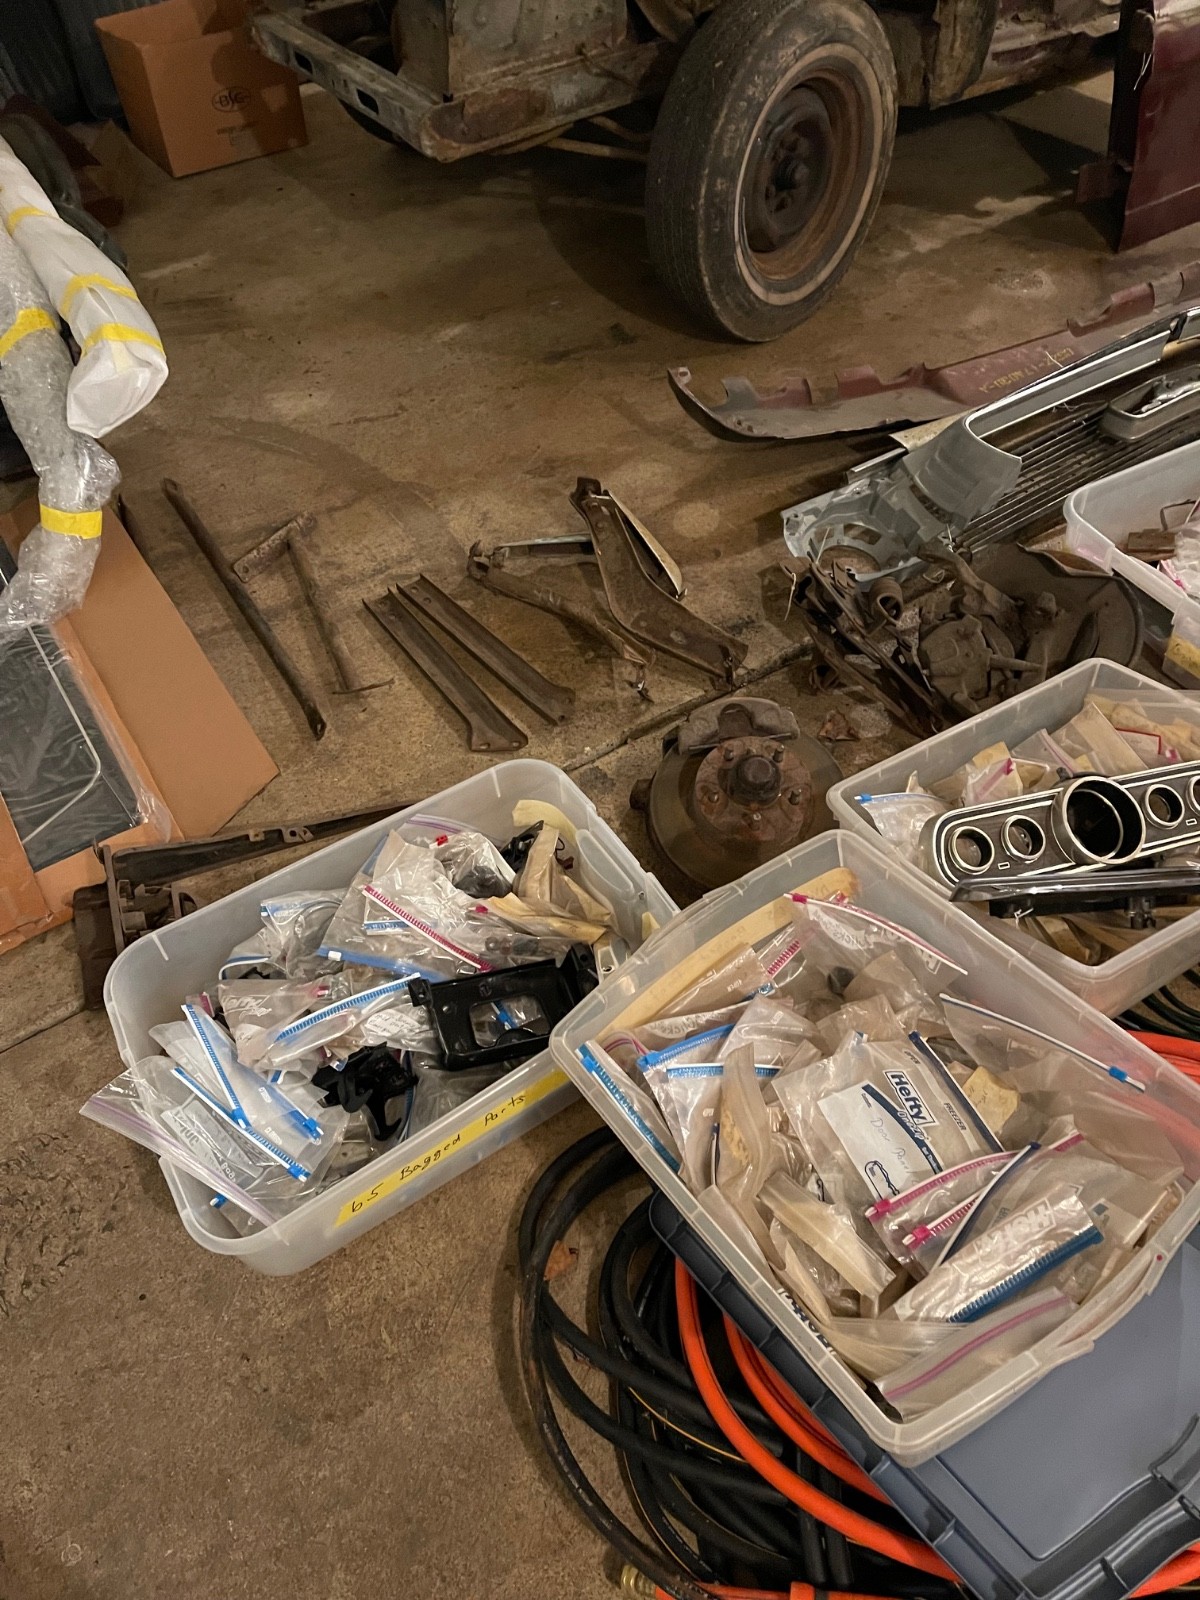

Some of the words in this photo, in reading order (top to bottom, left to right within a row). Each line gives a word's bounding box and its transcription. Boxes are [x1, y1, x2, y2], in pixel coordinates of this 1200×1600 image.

[890, 1073, 928, 1121] Hefty
[870, 1118, 891, 1142] Door
[943, 1102, 967, 1131] FREEZER
[400, 1134, 461, 1181] Bagged
[484, 1096, 526, 1127] Parts
